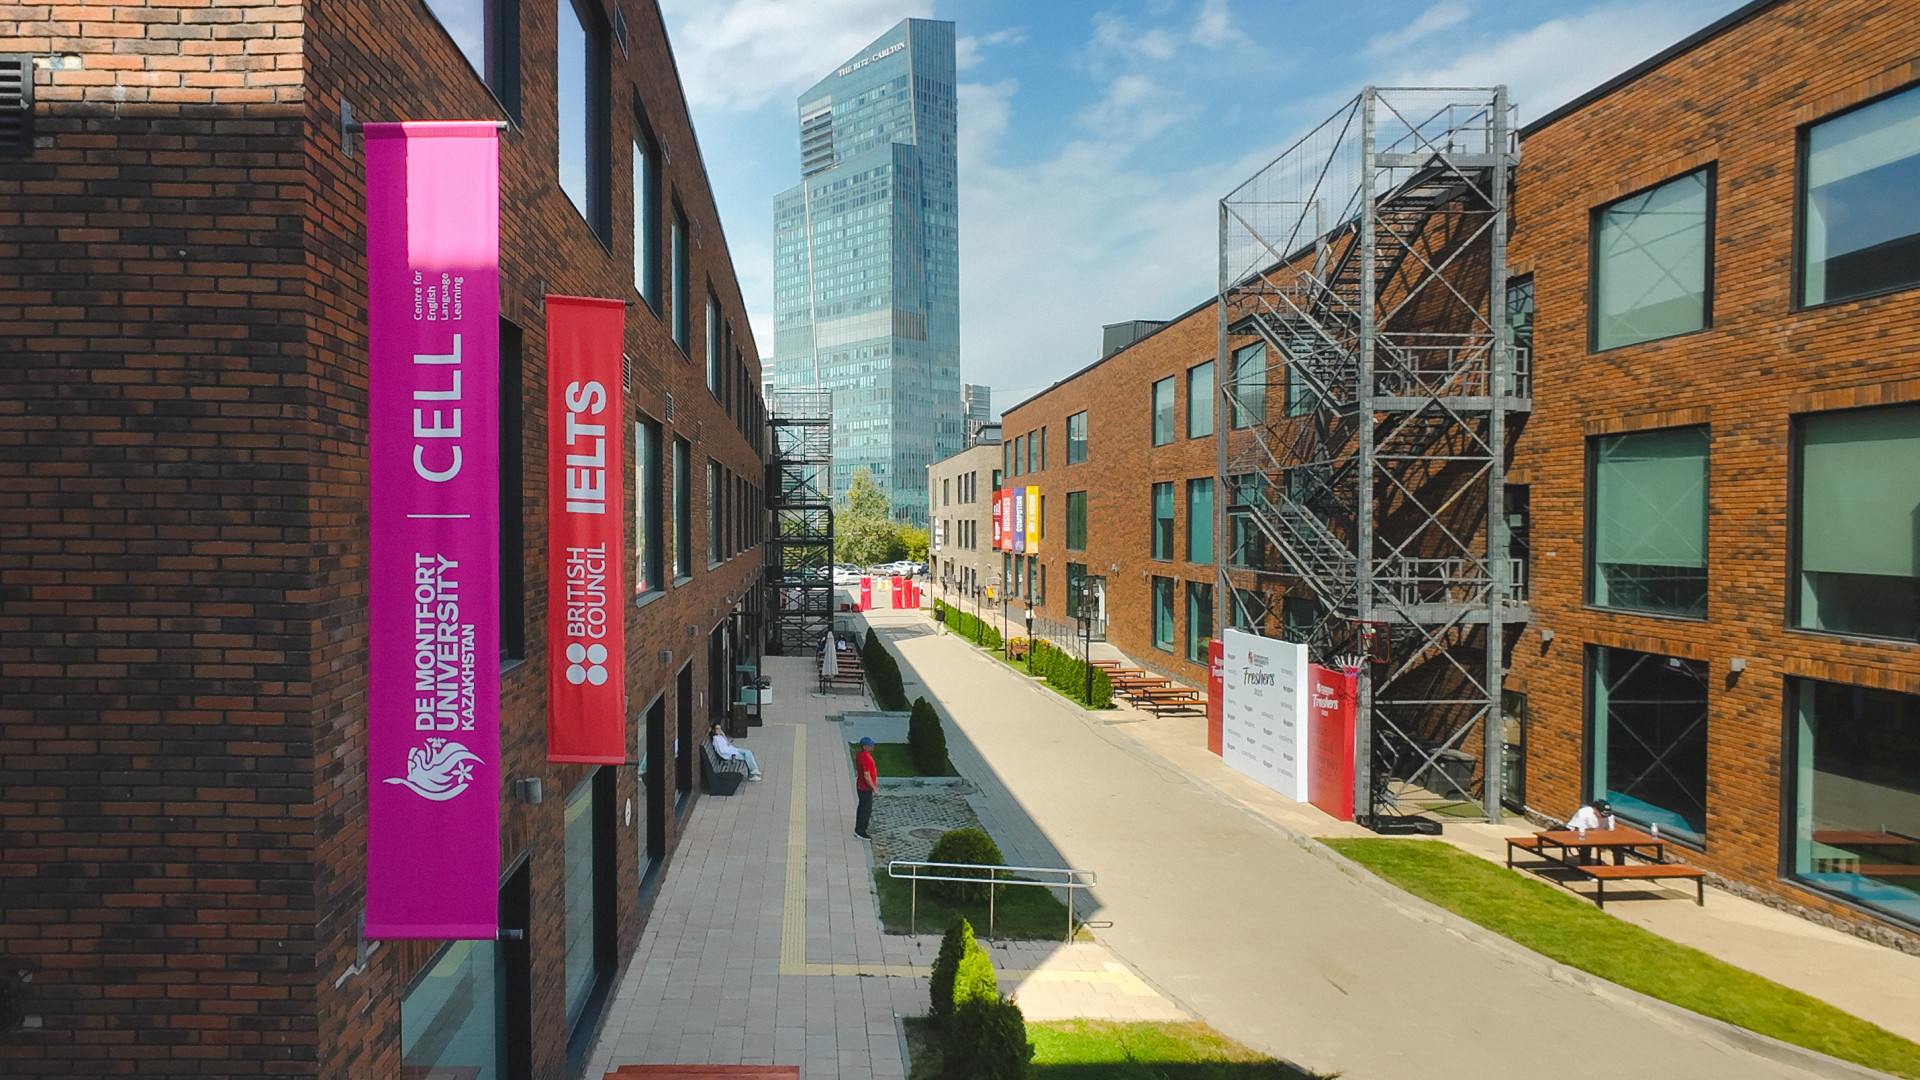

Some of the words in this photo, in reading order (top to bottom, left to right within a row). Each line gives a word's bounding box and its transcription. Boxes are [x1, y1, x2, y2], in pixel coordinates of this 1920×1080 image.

[413, 270, 422, 285] for
[440, 272, 451, 321] Language
[453, 276, 464, 321] Learning
[413, 287, 422, 321] Centre
[427, 285, 439, 321] English
[413, 333, 463, 483] CELL
[565, 381, 607, 514] IELTS
[1003, 496, 1011, 532] BUSINESS
[566, 547, 586, 637] BRITISH
[586, 541, 607, 639] COUNCIL
[414, 552, 436, 691] MONTFORT
[436, 553, 459, 731] UNIVERSITY
[461, 624, 475, 731] KAZAKHSTAN
[1243, 667, 1275, 686] Freshers
[415, 697, 435, 731] DE
[1312, 693, 1339, 710] Freshers
